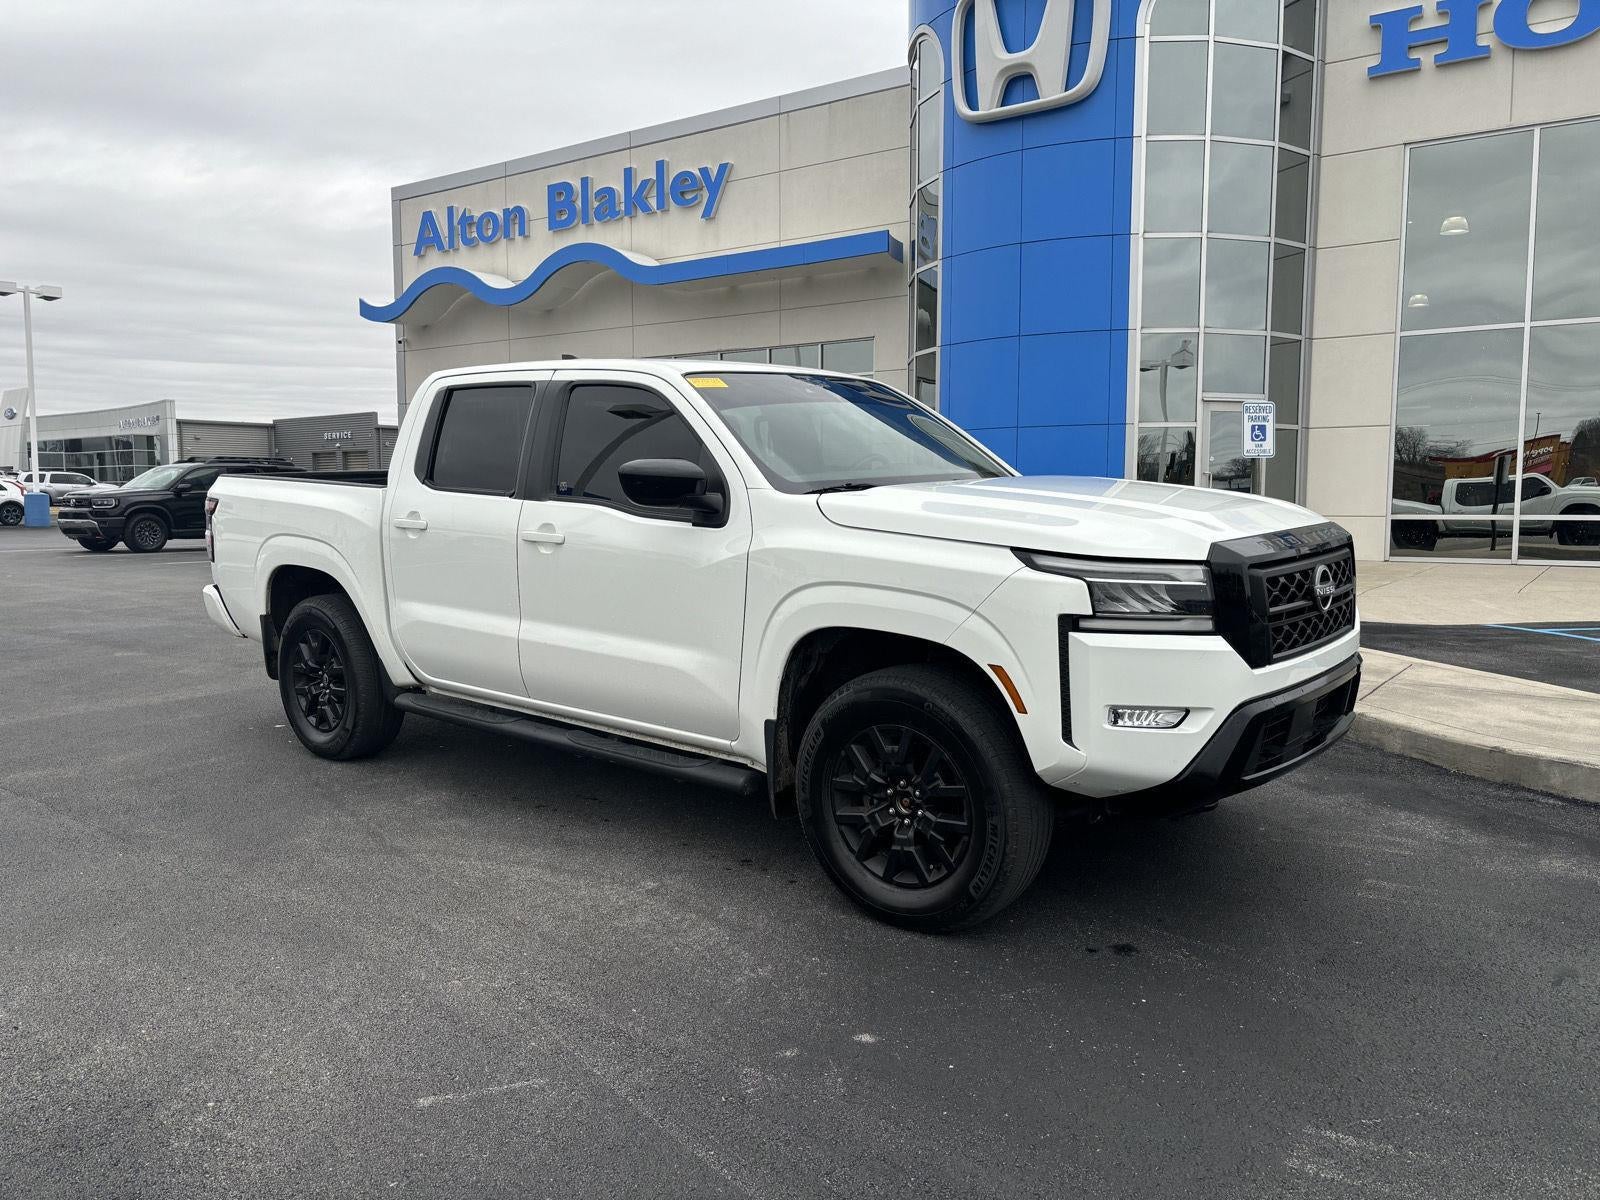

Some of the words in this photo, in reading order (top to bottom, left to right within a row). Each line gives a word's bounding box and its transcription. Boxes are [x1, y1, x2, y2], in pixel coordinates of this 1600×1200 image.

[413, 205, 530, 256] Alton
[547, 159, 734, 233] Blakley
[1244, 405, 1273, 414] RESERVED
[1247, 415, 1270, 423] PARKING
[323, 431, 352, 440] SERVICE
[972, 822, 1000, 896] MICHELIN
